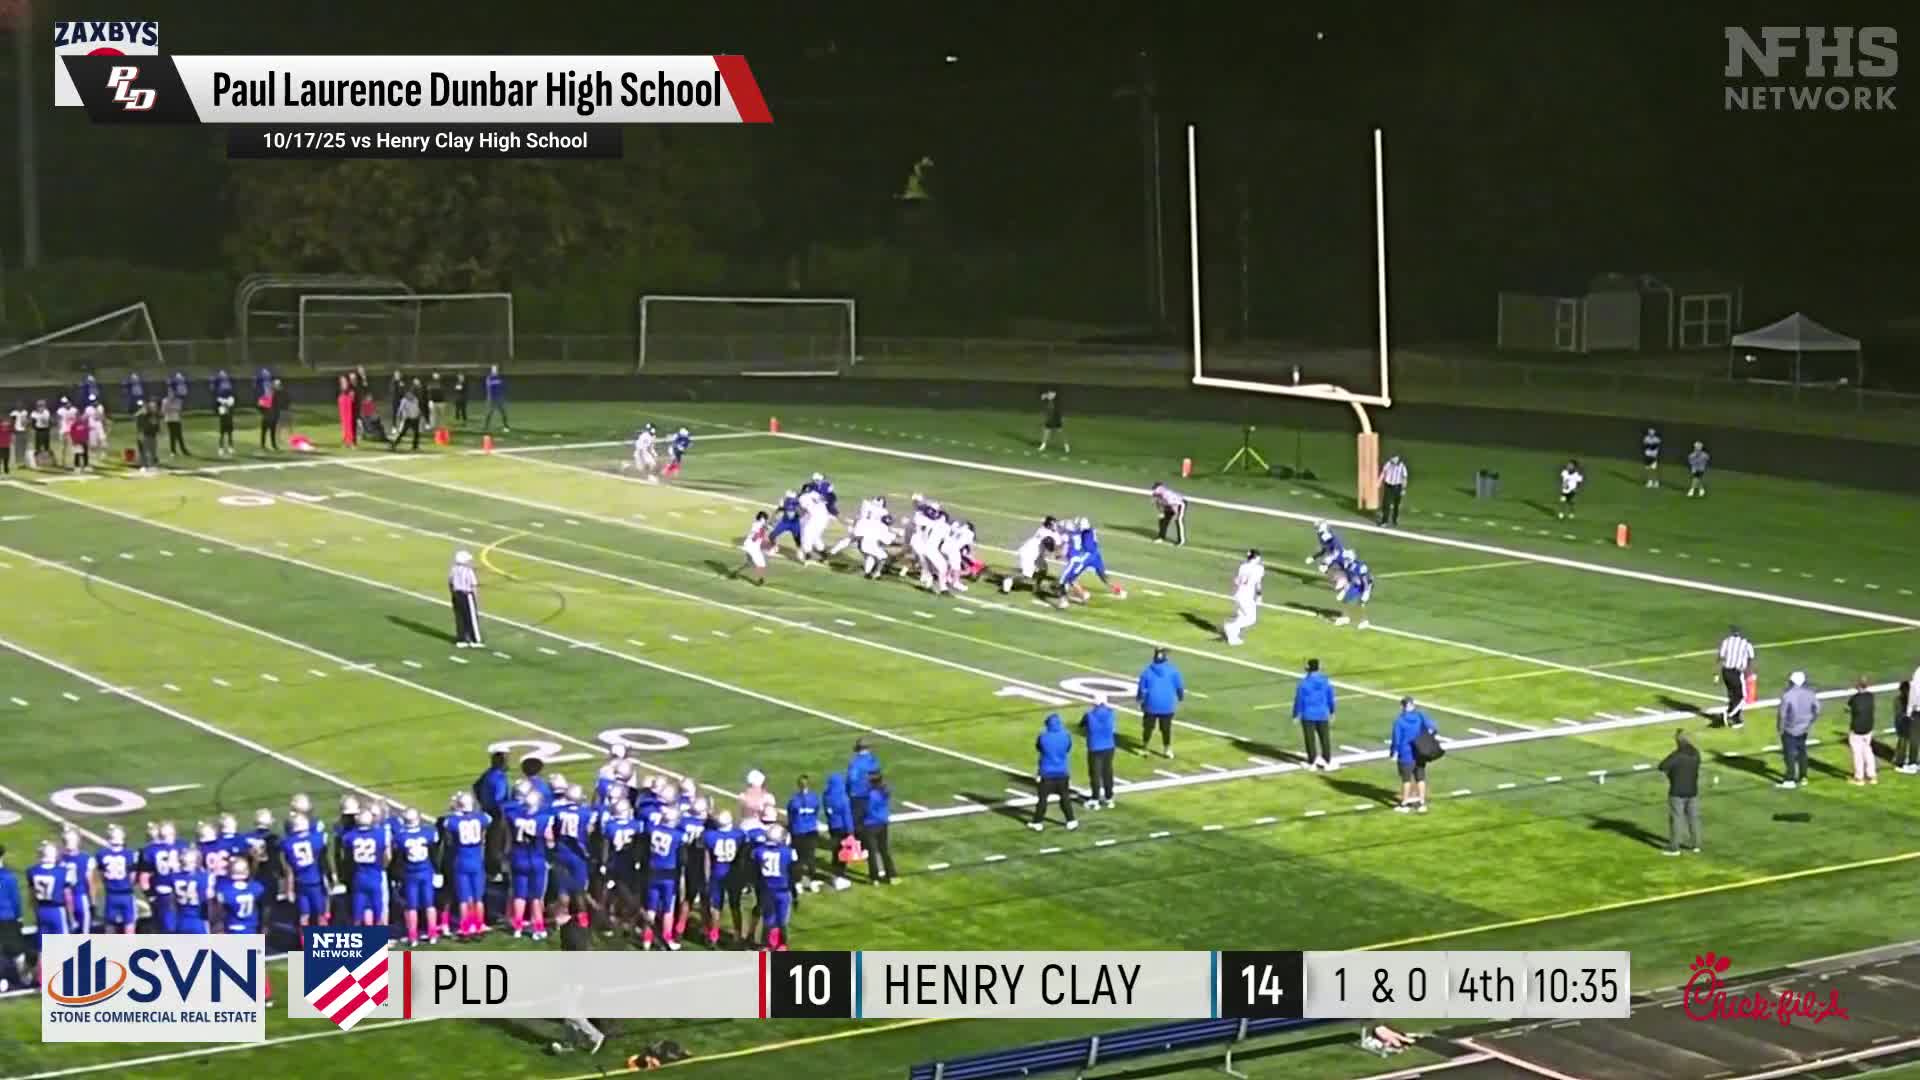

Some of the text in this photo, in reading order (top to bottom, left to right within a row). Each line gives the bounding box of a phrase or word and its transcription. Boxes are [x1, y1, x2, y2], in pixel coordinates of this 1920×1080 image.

[353, 837, 377, 864] 22
[761, 851, 782, 877] 31
[33, 875, 56, 900] 57
[174, 880, 200, 906] 54
